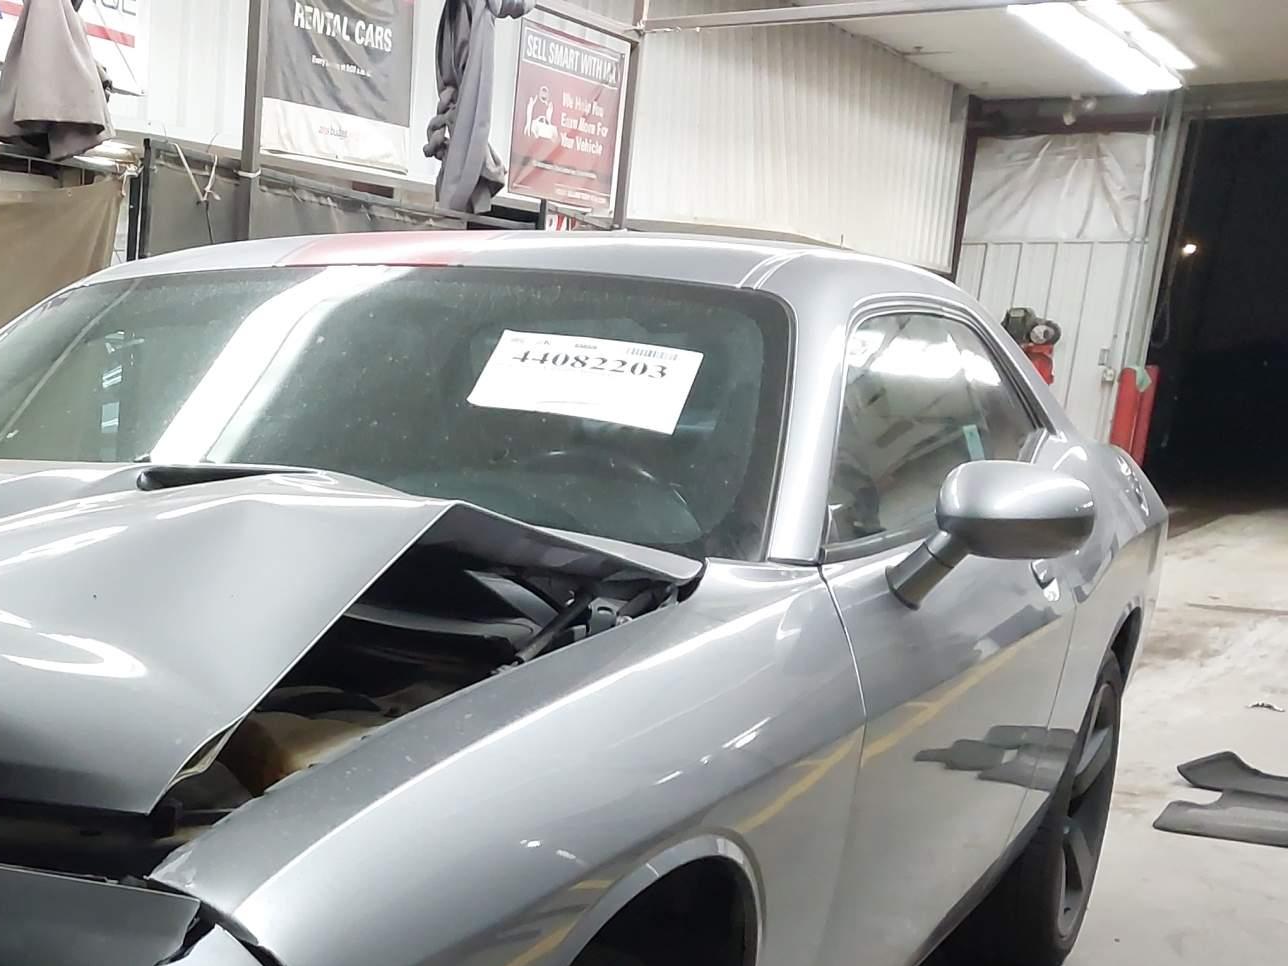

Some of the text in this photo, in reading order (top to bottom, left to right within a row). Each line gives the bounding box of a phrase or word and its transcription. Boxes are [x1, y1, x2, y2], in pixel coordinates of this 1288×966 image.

[293, 1, 393, 53] RENTAL CARS
[526, 34, 547, 62] SELL
[548, 42, 580, 73] SMART
[581, 52, 603, 81] WITH
[511, 349, 669, 379] 44082203
